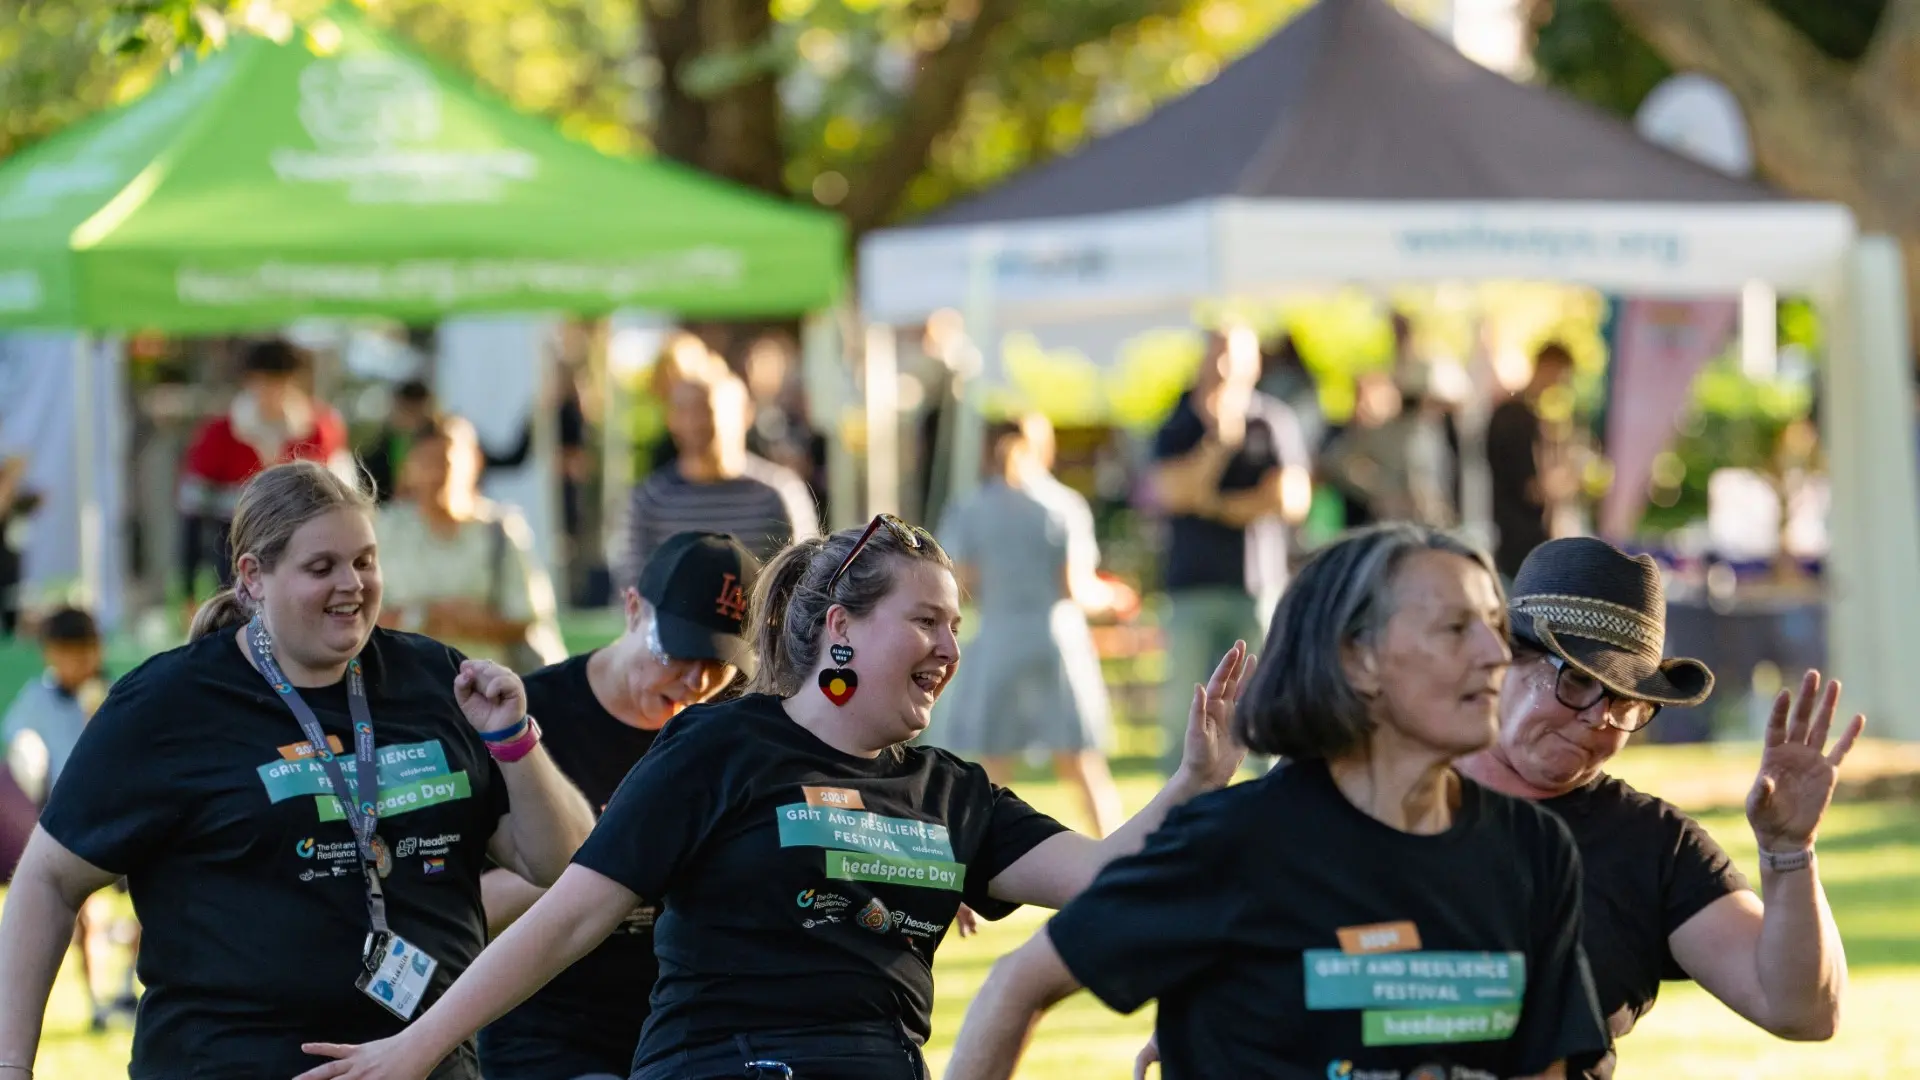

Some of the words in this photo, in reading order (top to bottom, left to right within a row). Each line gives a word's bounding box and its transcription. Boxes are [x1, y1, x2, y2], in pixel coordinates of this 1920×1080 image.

[716, 573, 746, 620] LA
[832, 648, 852, 656] ALWAYS
[269, 763, 302, 778] GRIT
[400, 765, 437, 778] celebrates
[421, 782, 456, 798] Day
[820, 791, 848, 804] 2024
[786, 810, 822, 821] GRIT
[828, 812, 856, 826] AND
[860, 817, 937, 840] RESILIENCE
[316, 844, 330, 852] The
[330, 842, 343, 851] Grit
[834, 830, 900, 852] FESTIVAL
[317, 850, 356, 860] Resilience
[912, 845, 944, 856] celebrates
[842, 856, 925, 880] headspace
[929, 866, 956, 886] Day
[1315, 959, 1361, 977] GRIT
[1366, 959, 1407, 977] AND
[1409, 959, 1509, 979] RESILIENCE
[1372, 981, 1461, 1001] FESTIVAL
[1383, 1015, 1489, 1039] headspace
[1492, 1009, 1519, 1031] Da
